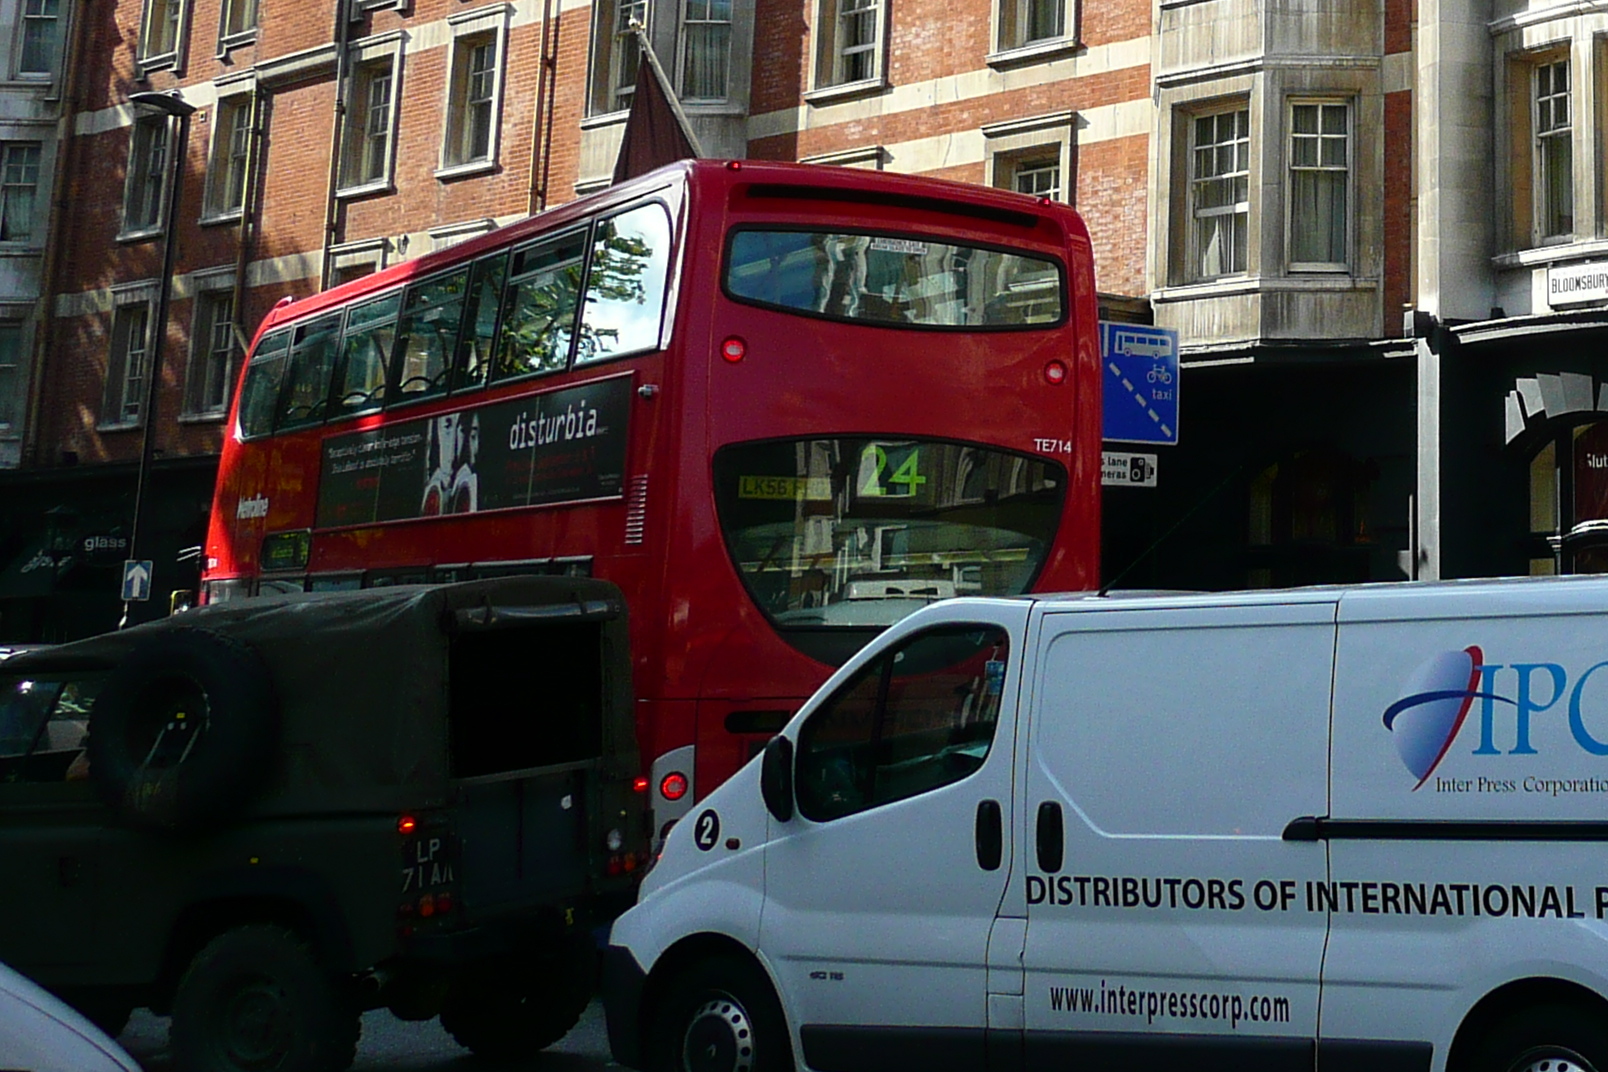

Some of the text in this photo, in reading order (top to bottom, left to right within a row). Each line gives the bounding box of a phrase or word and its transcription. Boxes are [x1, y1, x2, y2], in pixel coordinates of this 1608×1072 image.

[1152, 388, 1172, 400] taxi
[509, 399, 598, 450] disturbia
[1033, 438, 1072, 453] TE714
[860, 443, 927, 496] 24
[1108, 456, 1127, 467] lane
[743, 477, 788, 496] LK56
[84, 536, 127, 551] glass
[1435, 776, 1473, 792] Inter
[1477, 776, 1517, 792] Press
[699, 815, 714, 846] 2
[416, 837, 441, 863] LP
[401, 864, 423, 894] 71
[1026, 875, 1245, 911] DISTRIBUTORS
[1254, 880, 1296, 911] OF
[1306, 881, 1585, 919] INTERNATIONAL
[1050, 979, 1290, 1029] www.interpresscorp.com
